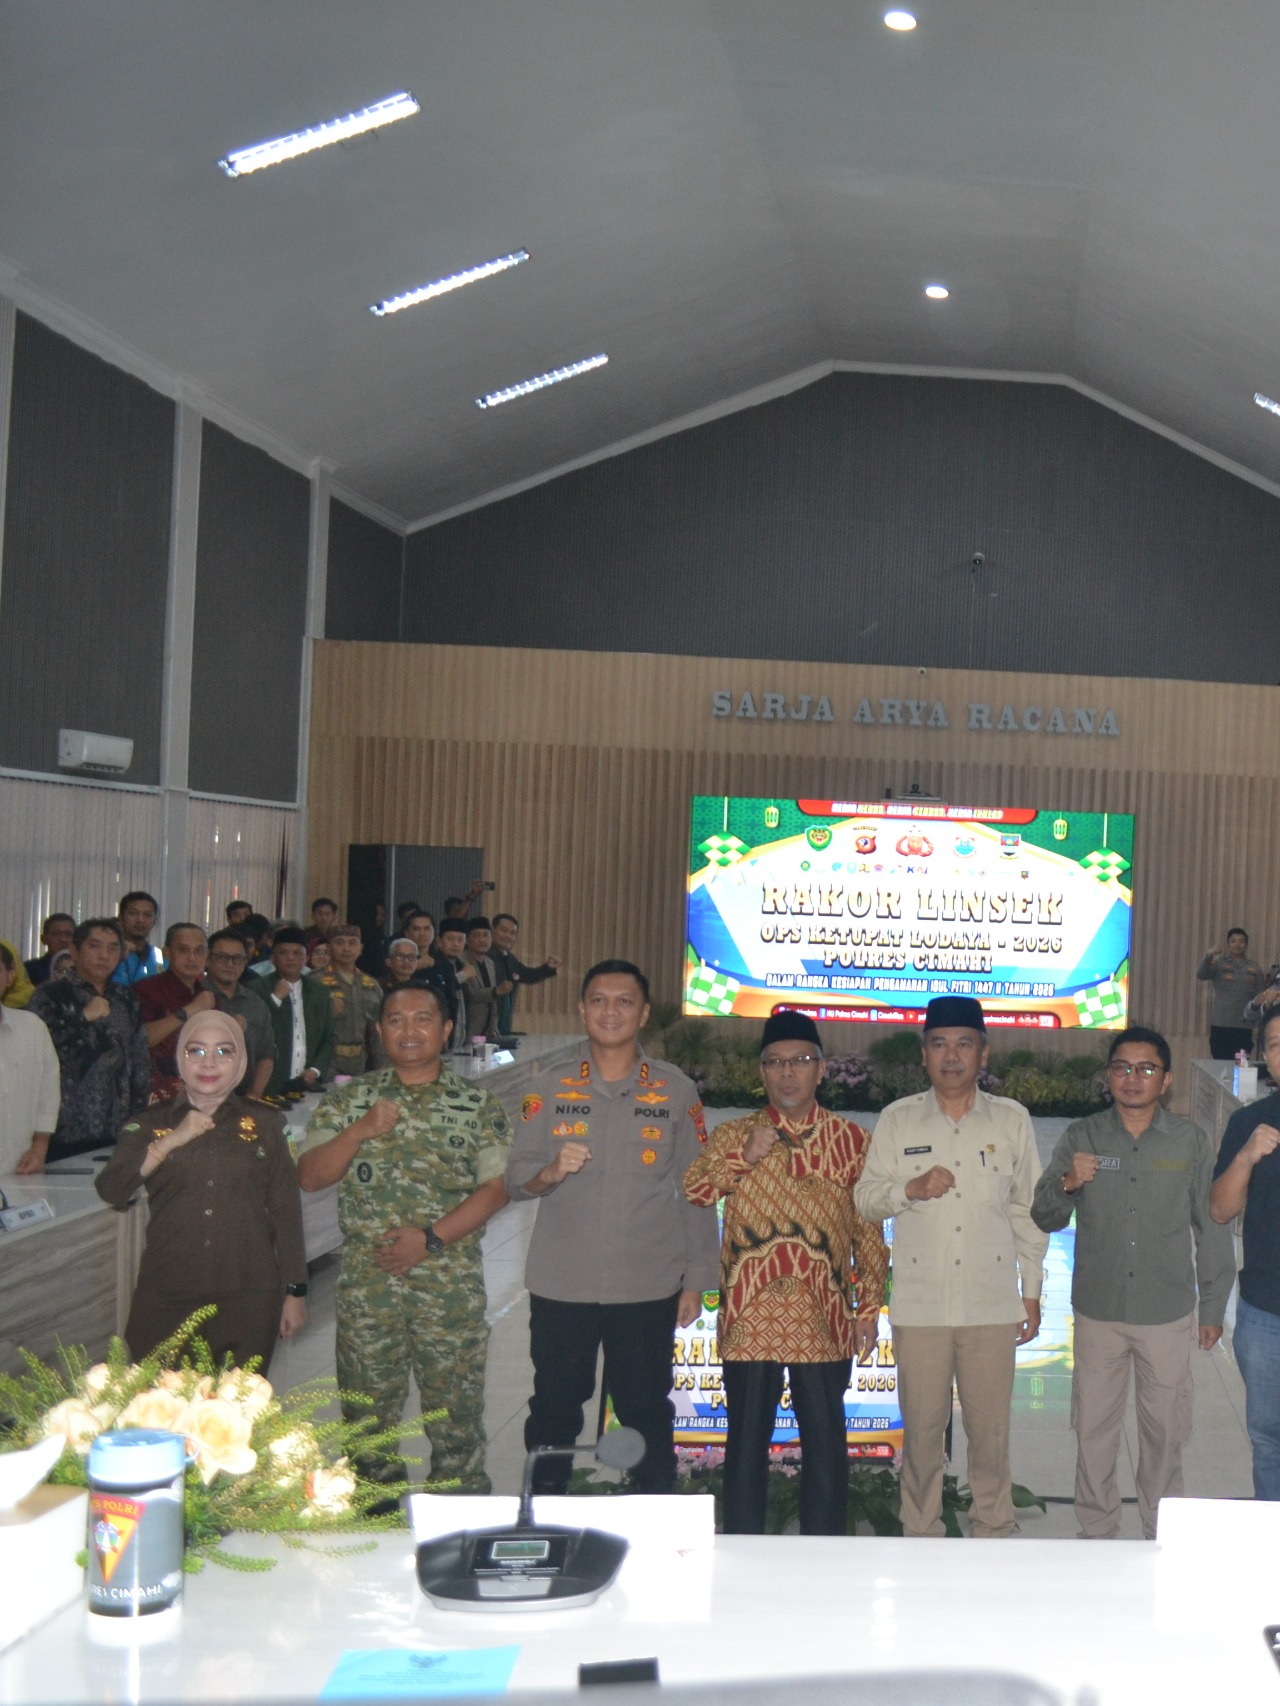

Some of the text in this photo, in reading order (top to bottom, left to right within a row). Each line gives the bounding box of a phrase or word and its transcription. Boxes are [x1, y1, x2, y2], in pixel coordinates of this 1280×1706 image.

[712, 691, 1120, 736] SARJA ARYA RACANA
[762, 881, 1063, 925] RAKOR LINSEK
[760, 922, 802, 944] OPS
[808, 924, 904, 948] KETUPAT
[910, 929, 991, 951] LODAYA
[1013, 935, 1063, 953] 2026
[824, 949, 993, 973] POLRES CIMAHI
[765, 973, 795, 987] DALAM
[795, 974, 829, 989] RANGKA
[831, 975, 872, 990] KESIAPAN
[873, 977, 929, 993] PENGAMANAN
[930, 979, 948, 993] IDUL
[951, 980, 972, 994] FITRI
[974, 980, 994, 995] 1447
[1004, 982, 1031, 996] TAHUN
[1032, 983, 1056, 997] 2026
[555, 1104, 591, 1115] NIKO
[634, 1107, 670, 1119] POLRI
[441, 1115, 478, 1130] TNI AD
[674, 1373, 695, 1391] PS
[857, 1374, 896, 1392] 2026
[689, 1416, 715, 1428] RANGKA
[850, 1417, 890, 1429] TAHUN 2026
[103, 1499, 139, 1516] POLRI
[110, 1584, 162, 1601] CIMAHI
